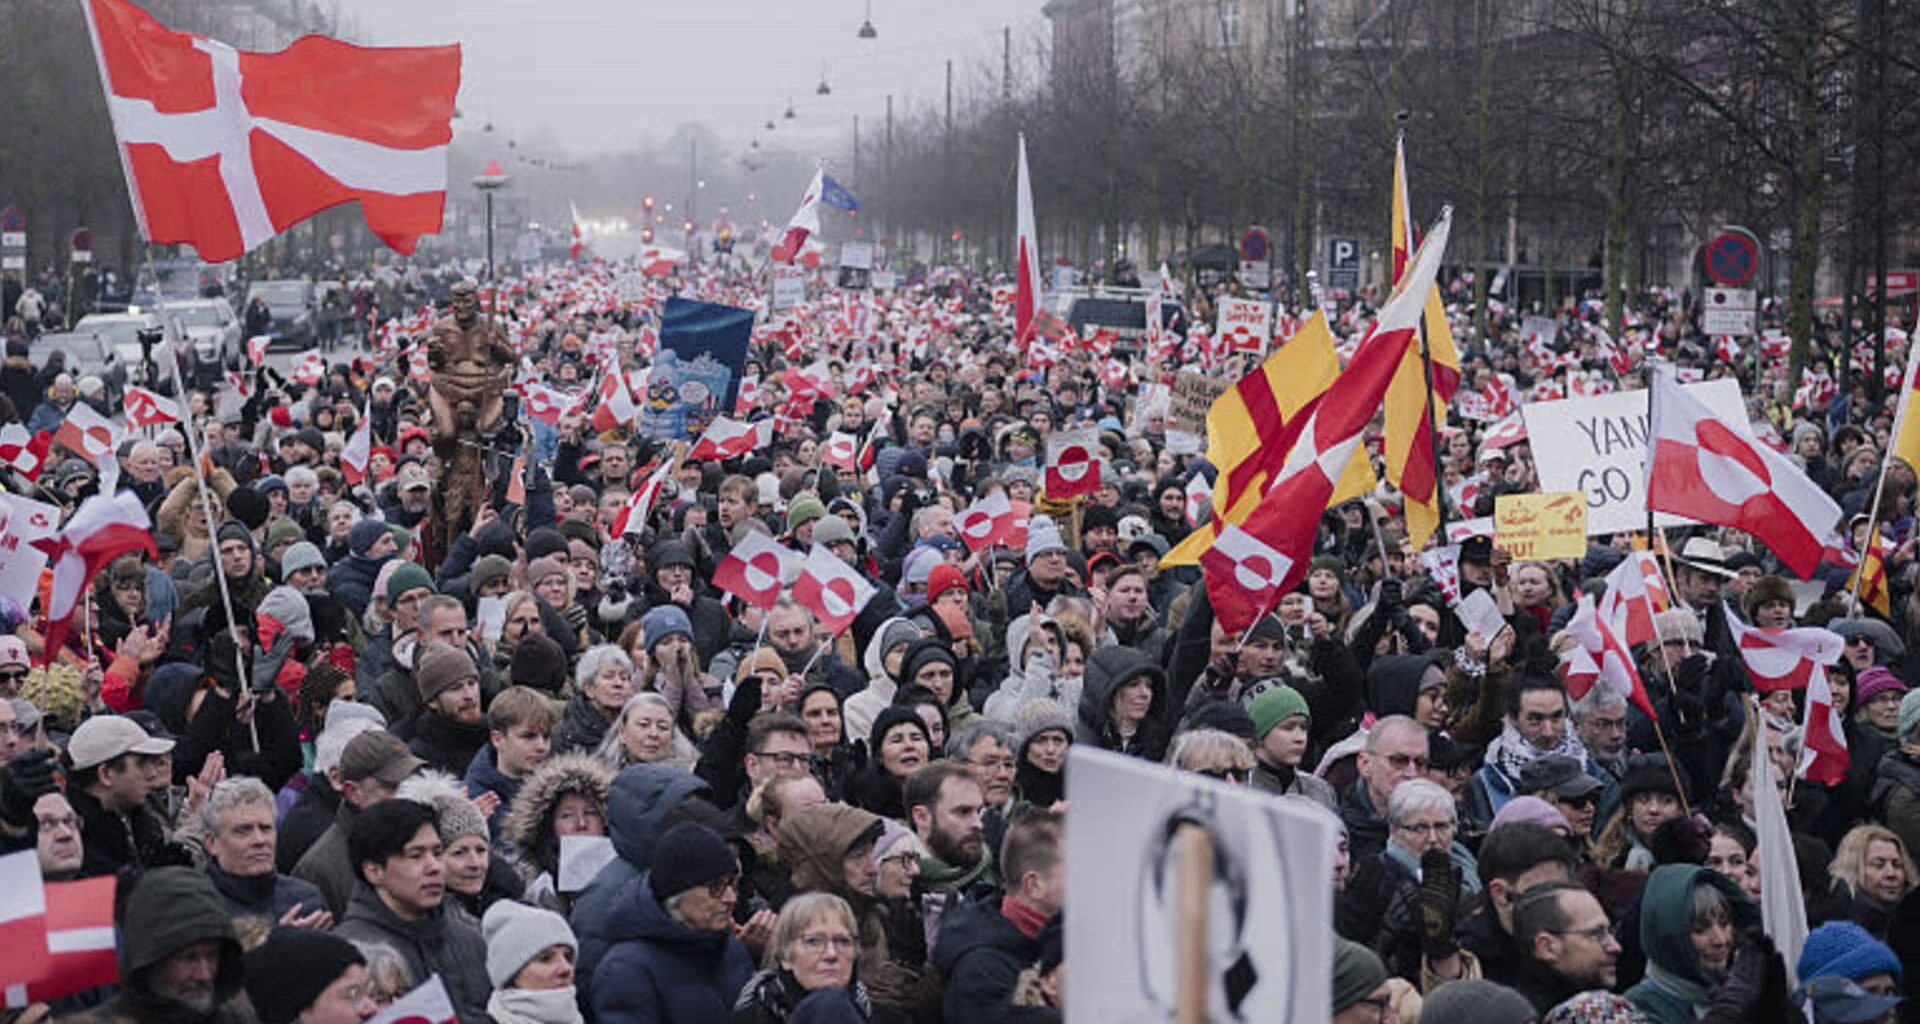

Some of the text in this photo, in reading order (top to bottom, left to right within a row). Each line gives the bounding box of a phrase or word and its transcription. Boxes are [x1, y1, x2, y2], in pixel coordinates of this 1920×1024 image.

[1335, 241, 1353, 266] P
[1576, 416, 1650, 455] YAN
[1577, 466, 1631, 507] GO
